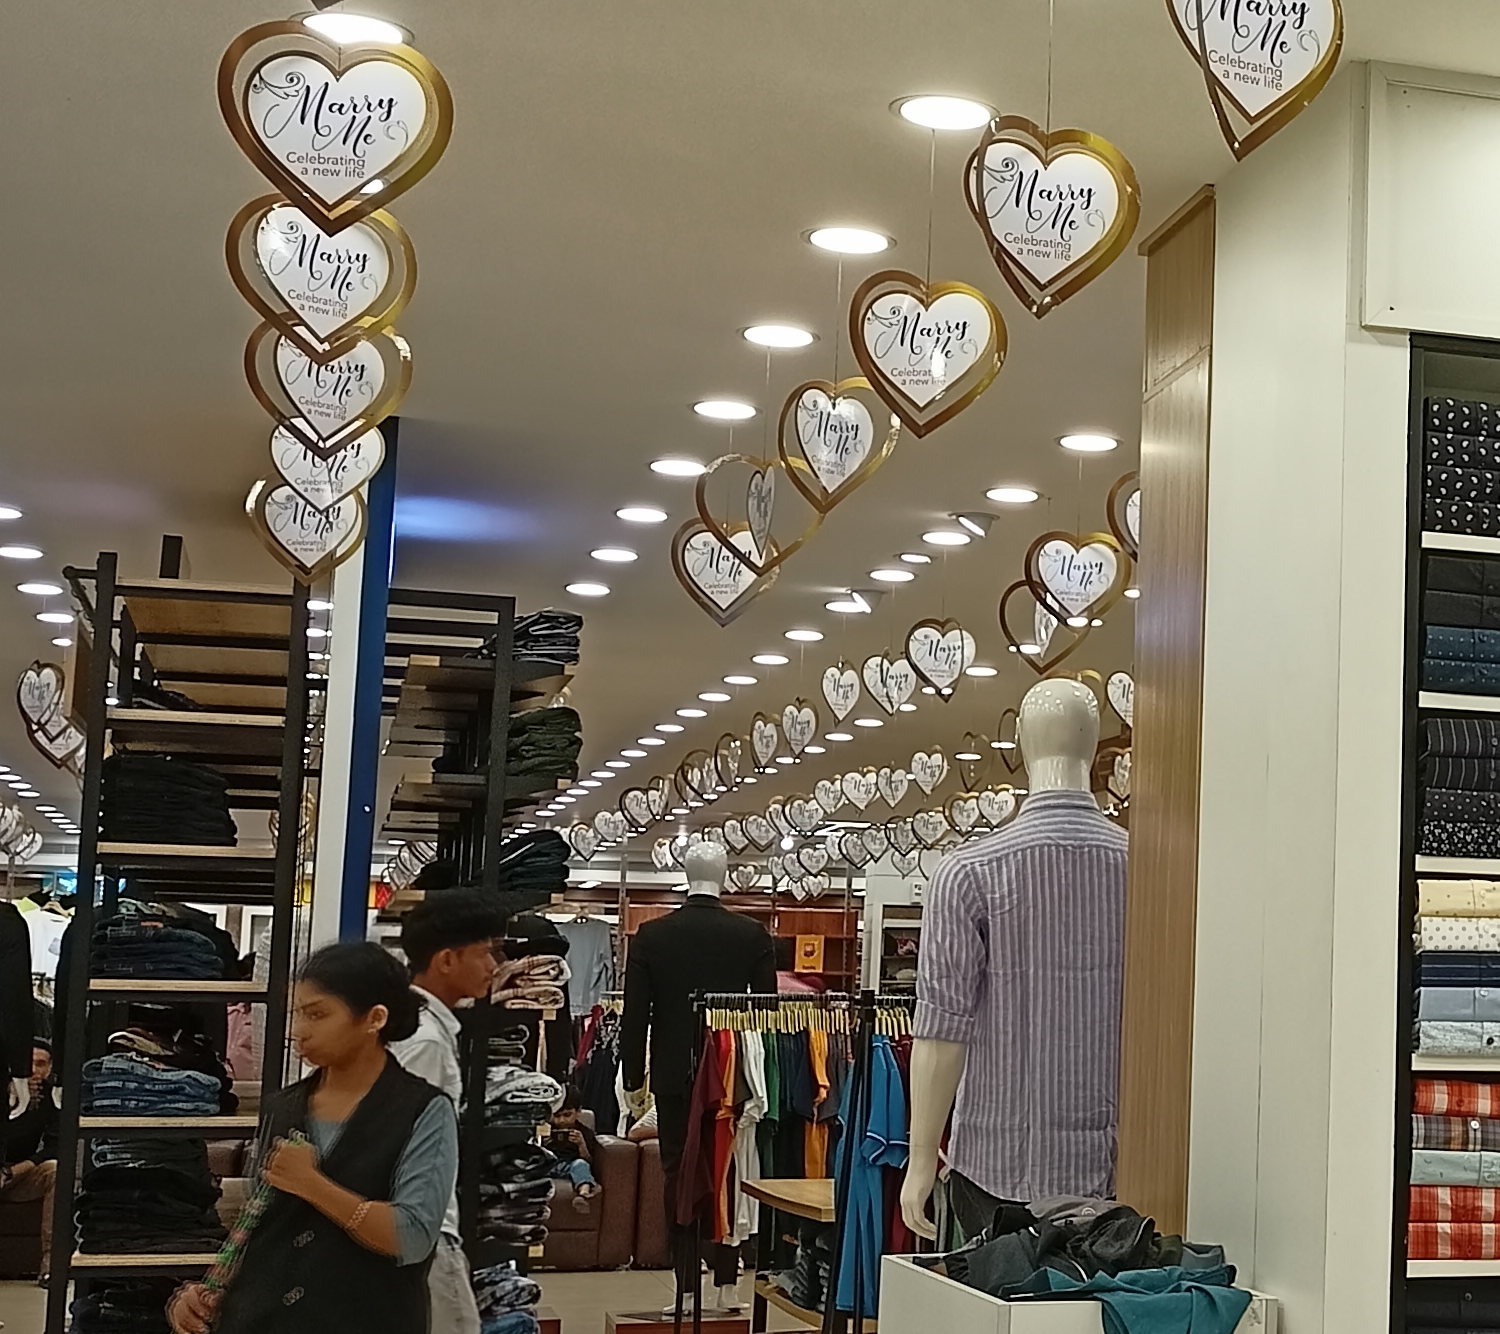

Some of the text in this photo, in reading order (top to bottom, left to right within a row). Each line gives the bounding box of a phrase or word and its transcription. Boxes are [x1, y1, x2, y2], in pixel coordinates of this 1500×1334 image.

[1232, 17, 1291, 68] Me
[1208, 50, 1283, 81] Celebrating
[1223, 69, 1283, 91] a new life
[263, 82, 397, 139] Marry
[312, 115, 376, 158] Me
[286, 151, 366, 170] Celebrating
[300, 167, 365, 179] a new life
[984, 169, 1095, 221] Marry
[1026, 202, 1079, 242] Me
[1004, 232, 1071, 253] Celebrating
[1017, 247, 1071, 261] a new life
[269, 234, 370, 281] Marry
[288, 289, 348, 311] Celebrating
[308, 304, 329, 315] new
[332, 307, 347, 319] life
[874, 312, 971, 359] Marry
[285, 359, 368, 388] Marry
[909, 378, 929, 386] new
[298, 396, 347, 414] Celebrating
[314, 409, 332, 418] new
[803, 411, 860, 446] Marry
[1045, 554, 1103, 582] Marry
